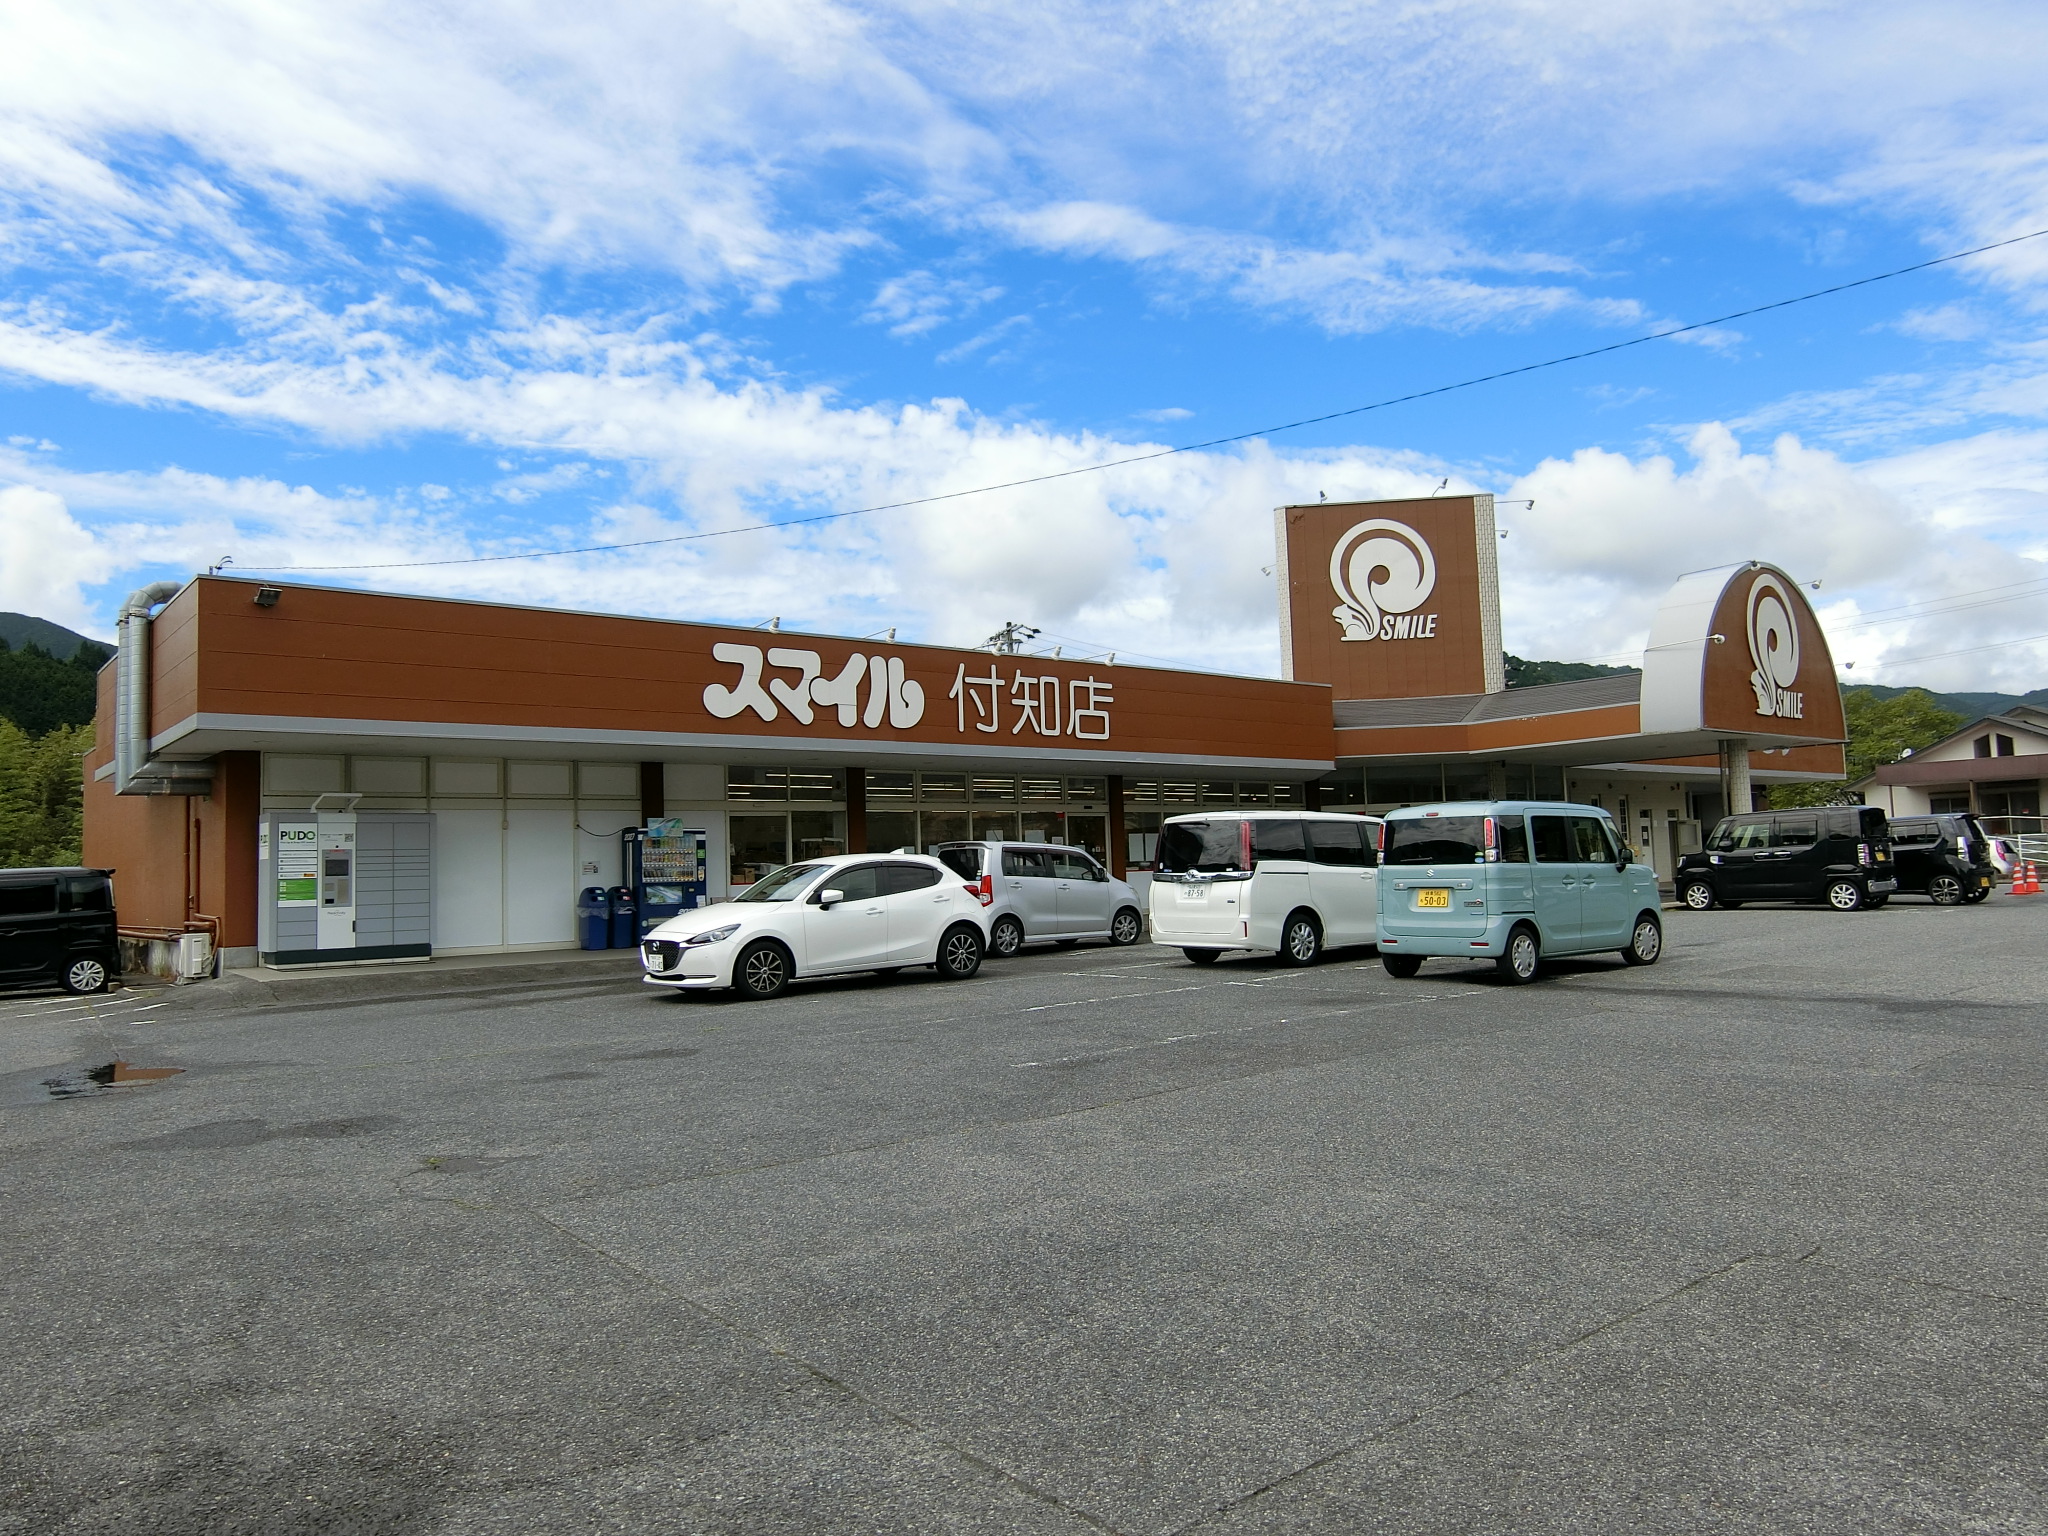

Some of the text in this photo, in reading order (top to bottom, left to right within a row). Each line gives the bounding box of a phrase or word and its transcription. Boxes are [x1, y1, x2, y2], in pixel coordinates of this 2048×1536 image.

[1380, 614, 1438, 640] SMILE
[703, 642, 1114, 740] スマイル 付知店
[1776, 688, 1803, 719] SMILE
[280, 830, 316, 841] PUDO
[1424, 896, 1447, 906] 50-03
